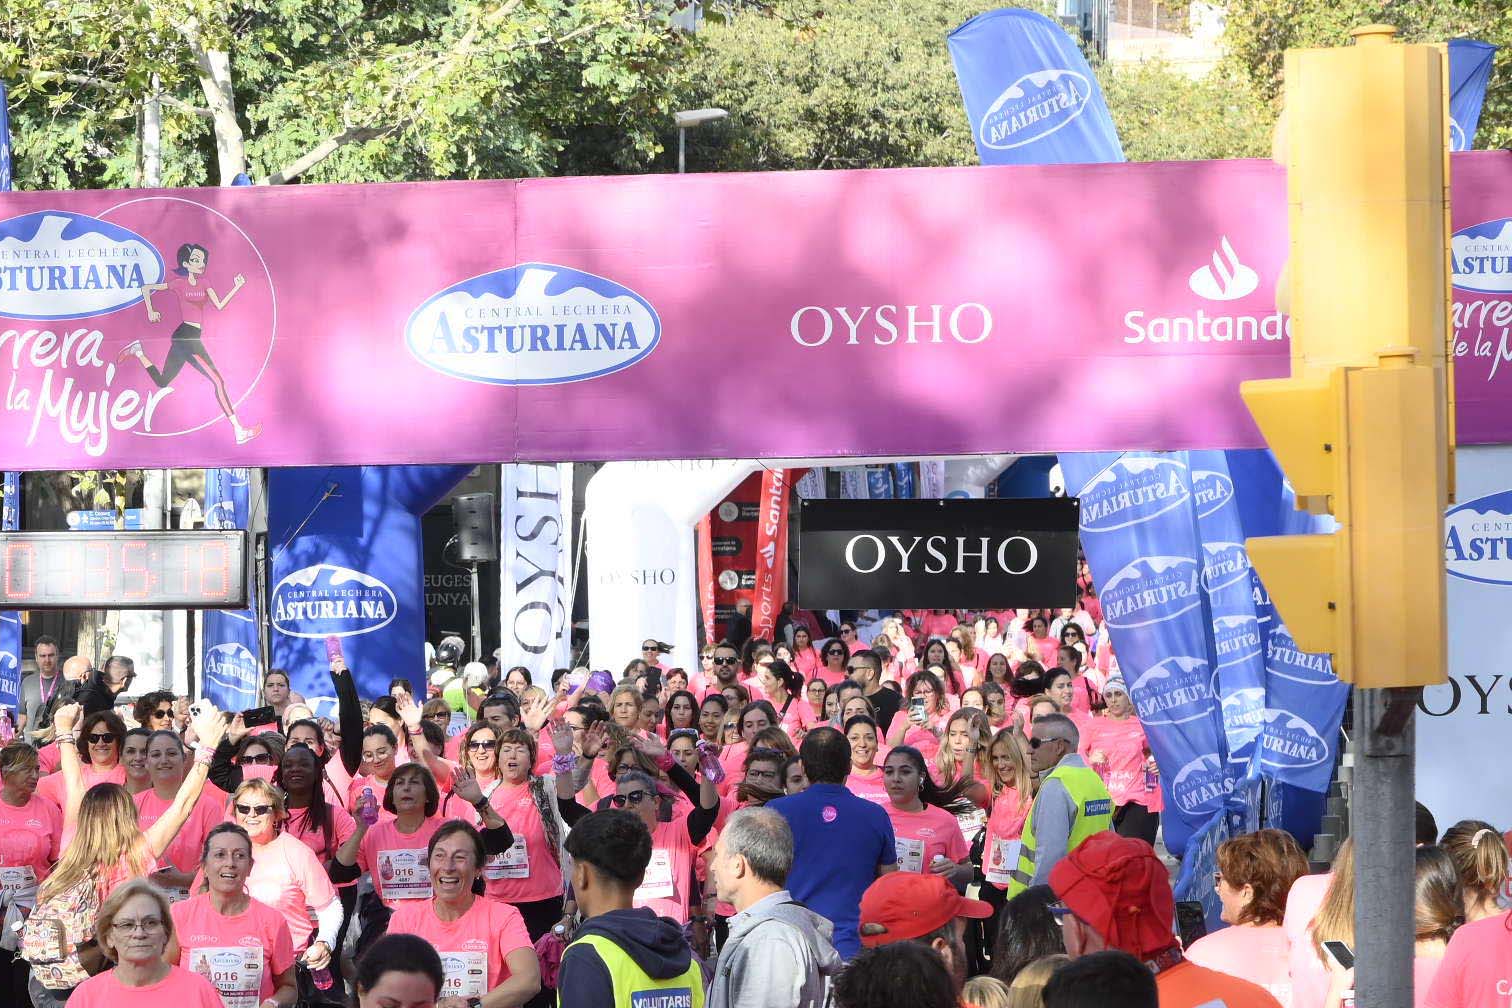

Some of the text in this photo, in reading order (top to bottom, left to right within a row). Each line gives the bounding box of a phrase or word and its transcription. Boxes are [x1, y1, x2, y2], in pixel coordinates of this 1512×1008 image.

[67, 247, 141, 258] LECHERA
[464, 304, 634, 318] CENTRAL LECHERA
[790, 302, 993, 347] OYSHO
[428, 312, 641, 354] ASTURIANA
[1475, 330, 1492, 357] la
[6, 372, 31, 411] la
[26, 364, 175, 456] Mujer
[844, 534, 1038, 575] OYSHO
[274, 595, 388, 622] ASTURIANA
[395, 868, 414, 877] 016
[214, 971, 238, 981] 016
